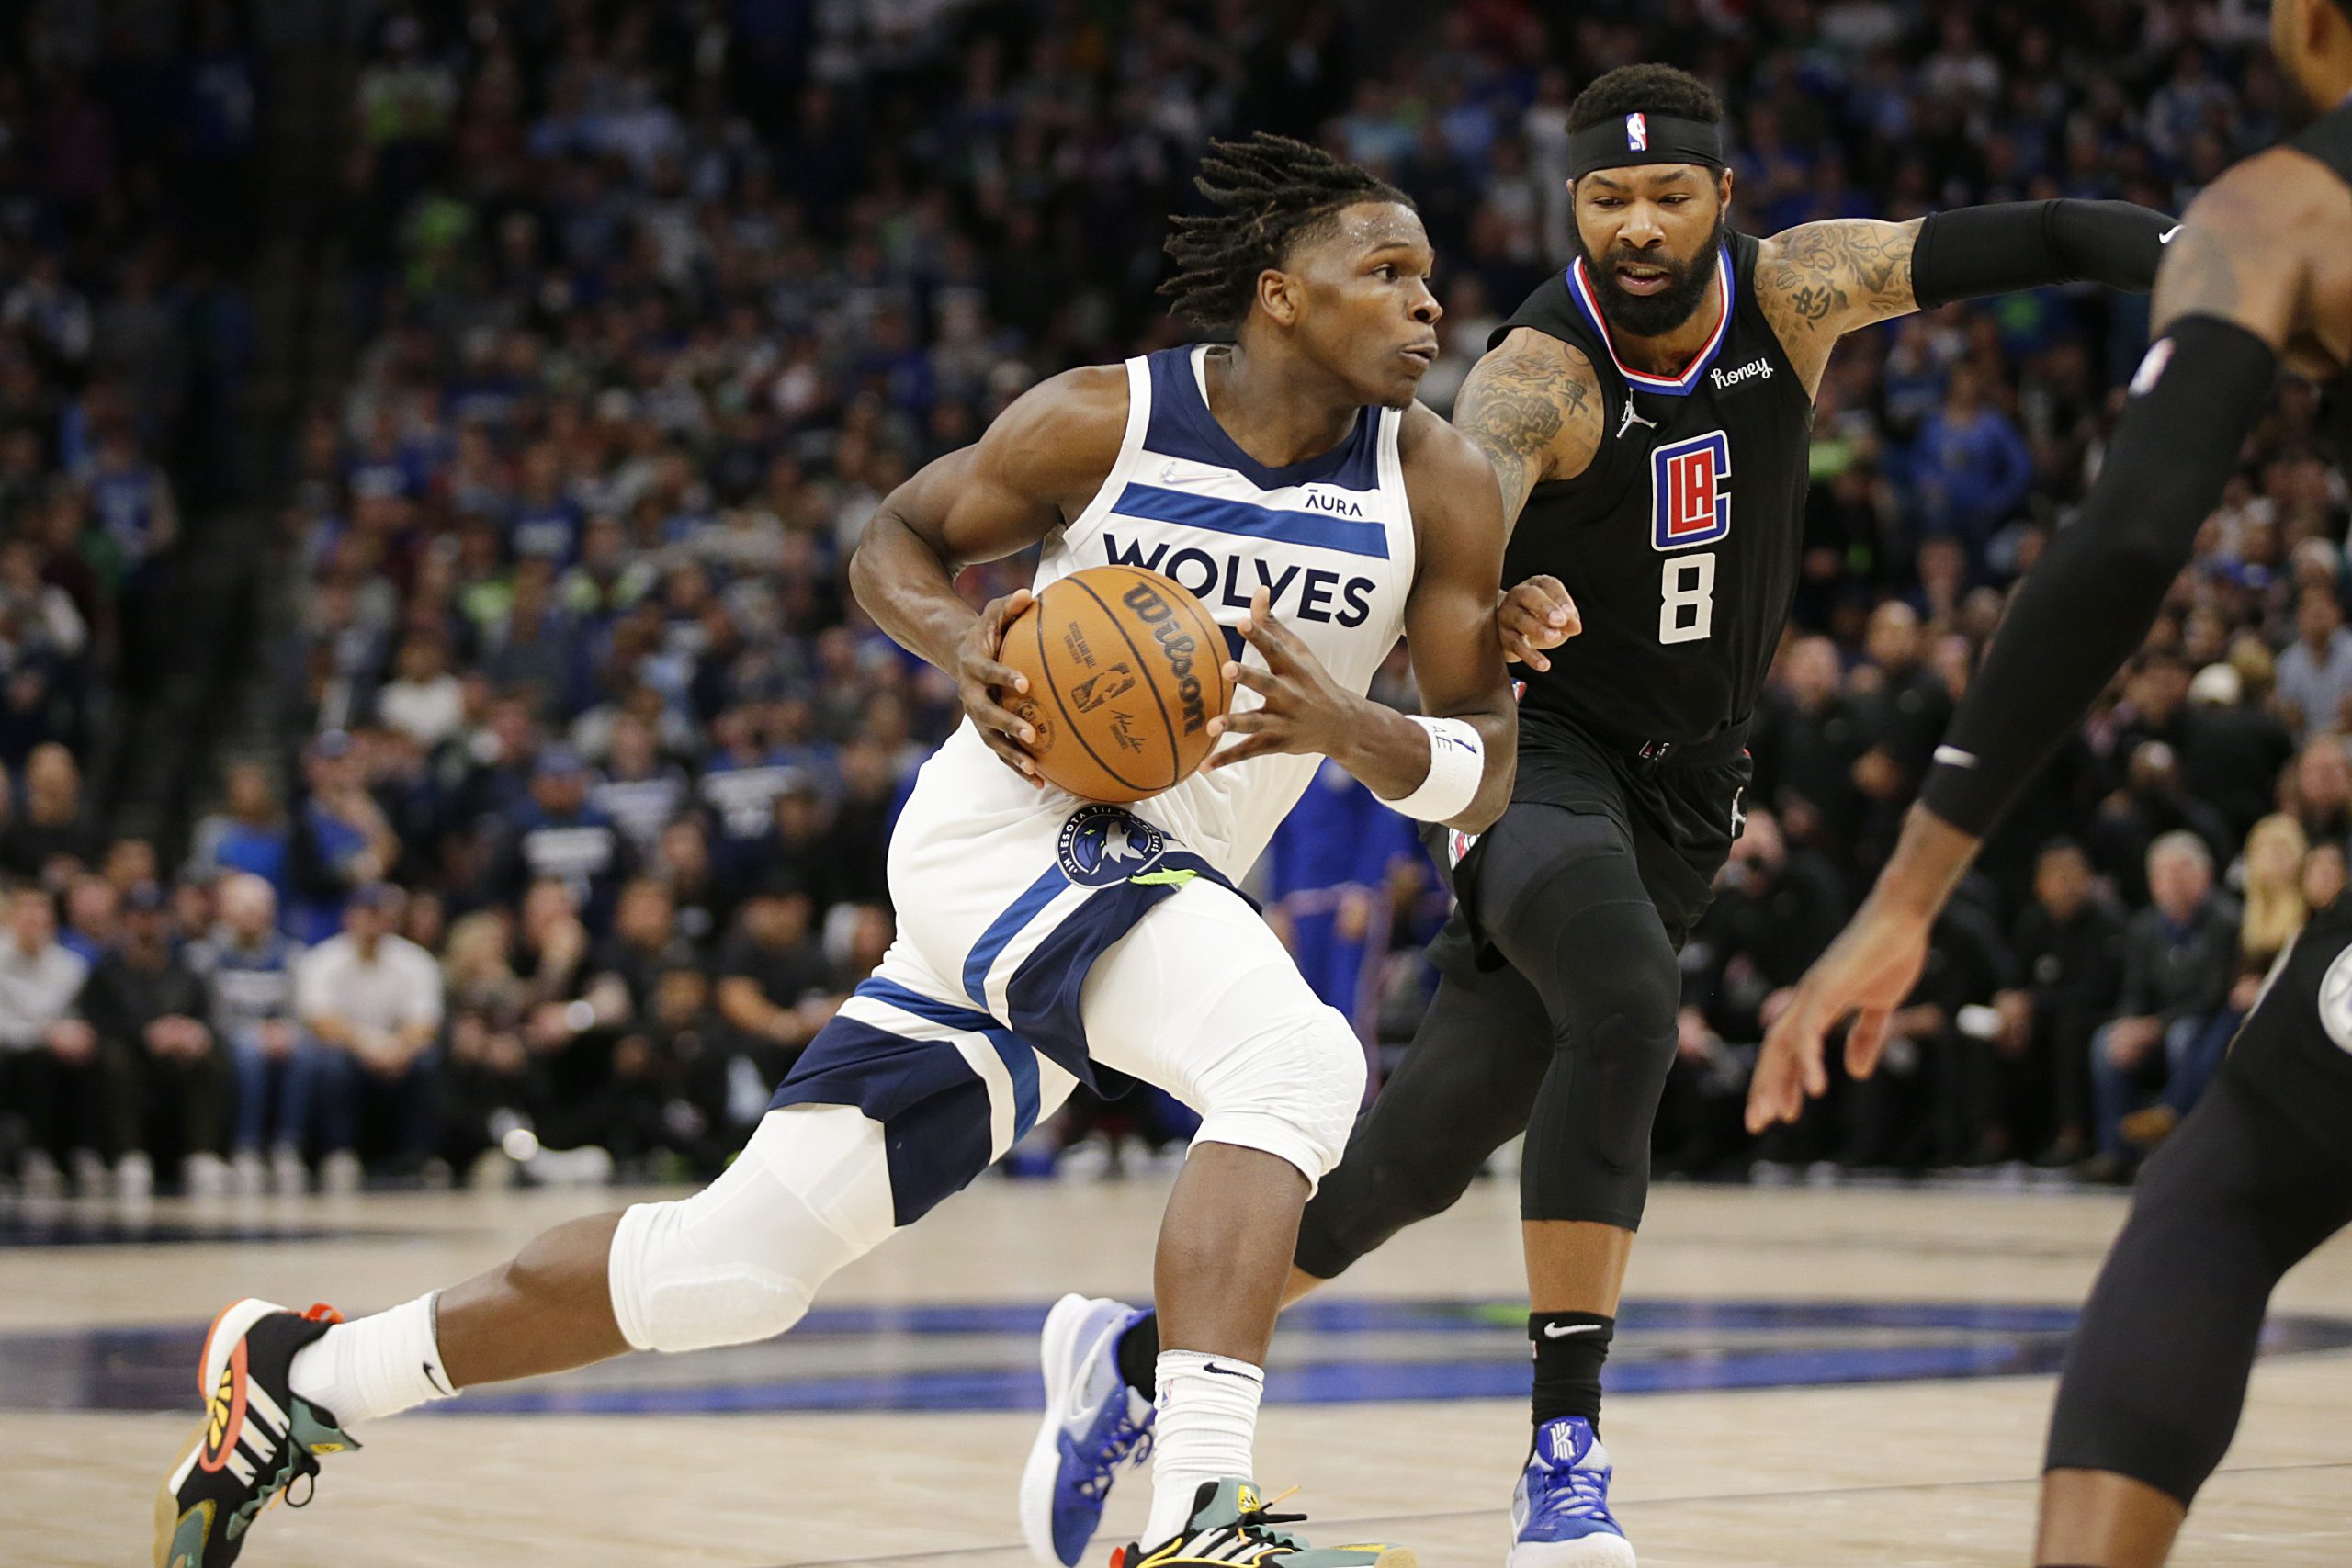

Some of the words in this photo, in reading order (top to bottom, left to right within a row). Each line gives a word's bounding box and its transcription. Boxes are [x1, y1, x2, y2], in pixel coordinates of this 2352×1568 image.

[1710, 357, 1773, 389] honey
[1102, 533, 1376, 627] WOLVES
[1659, 552, 1716, 645] 8
[1122, 581, 1206, 738] Wilson
